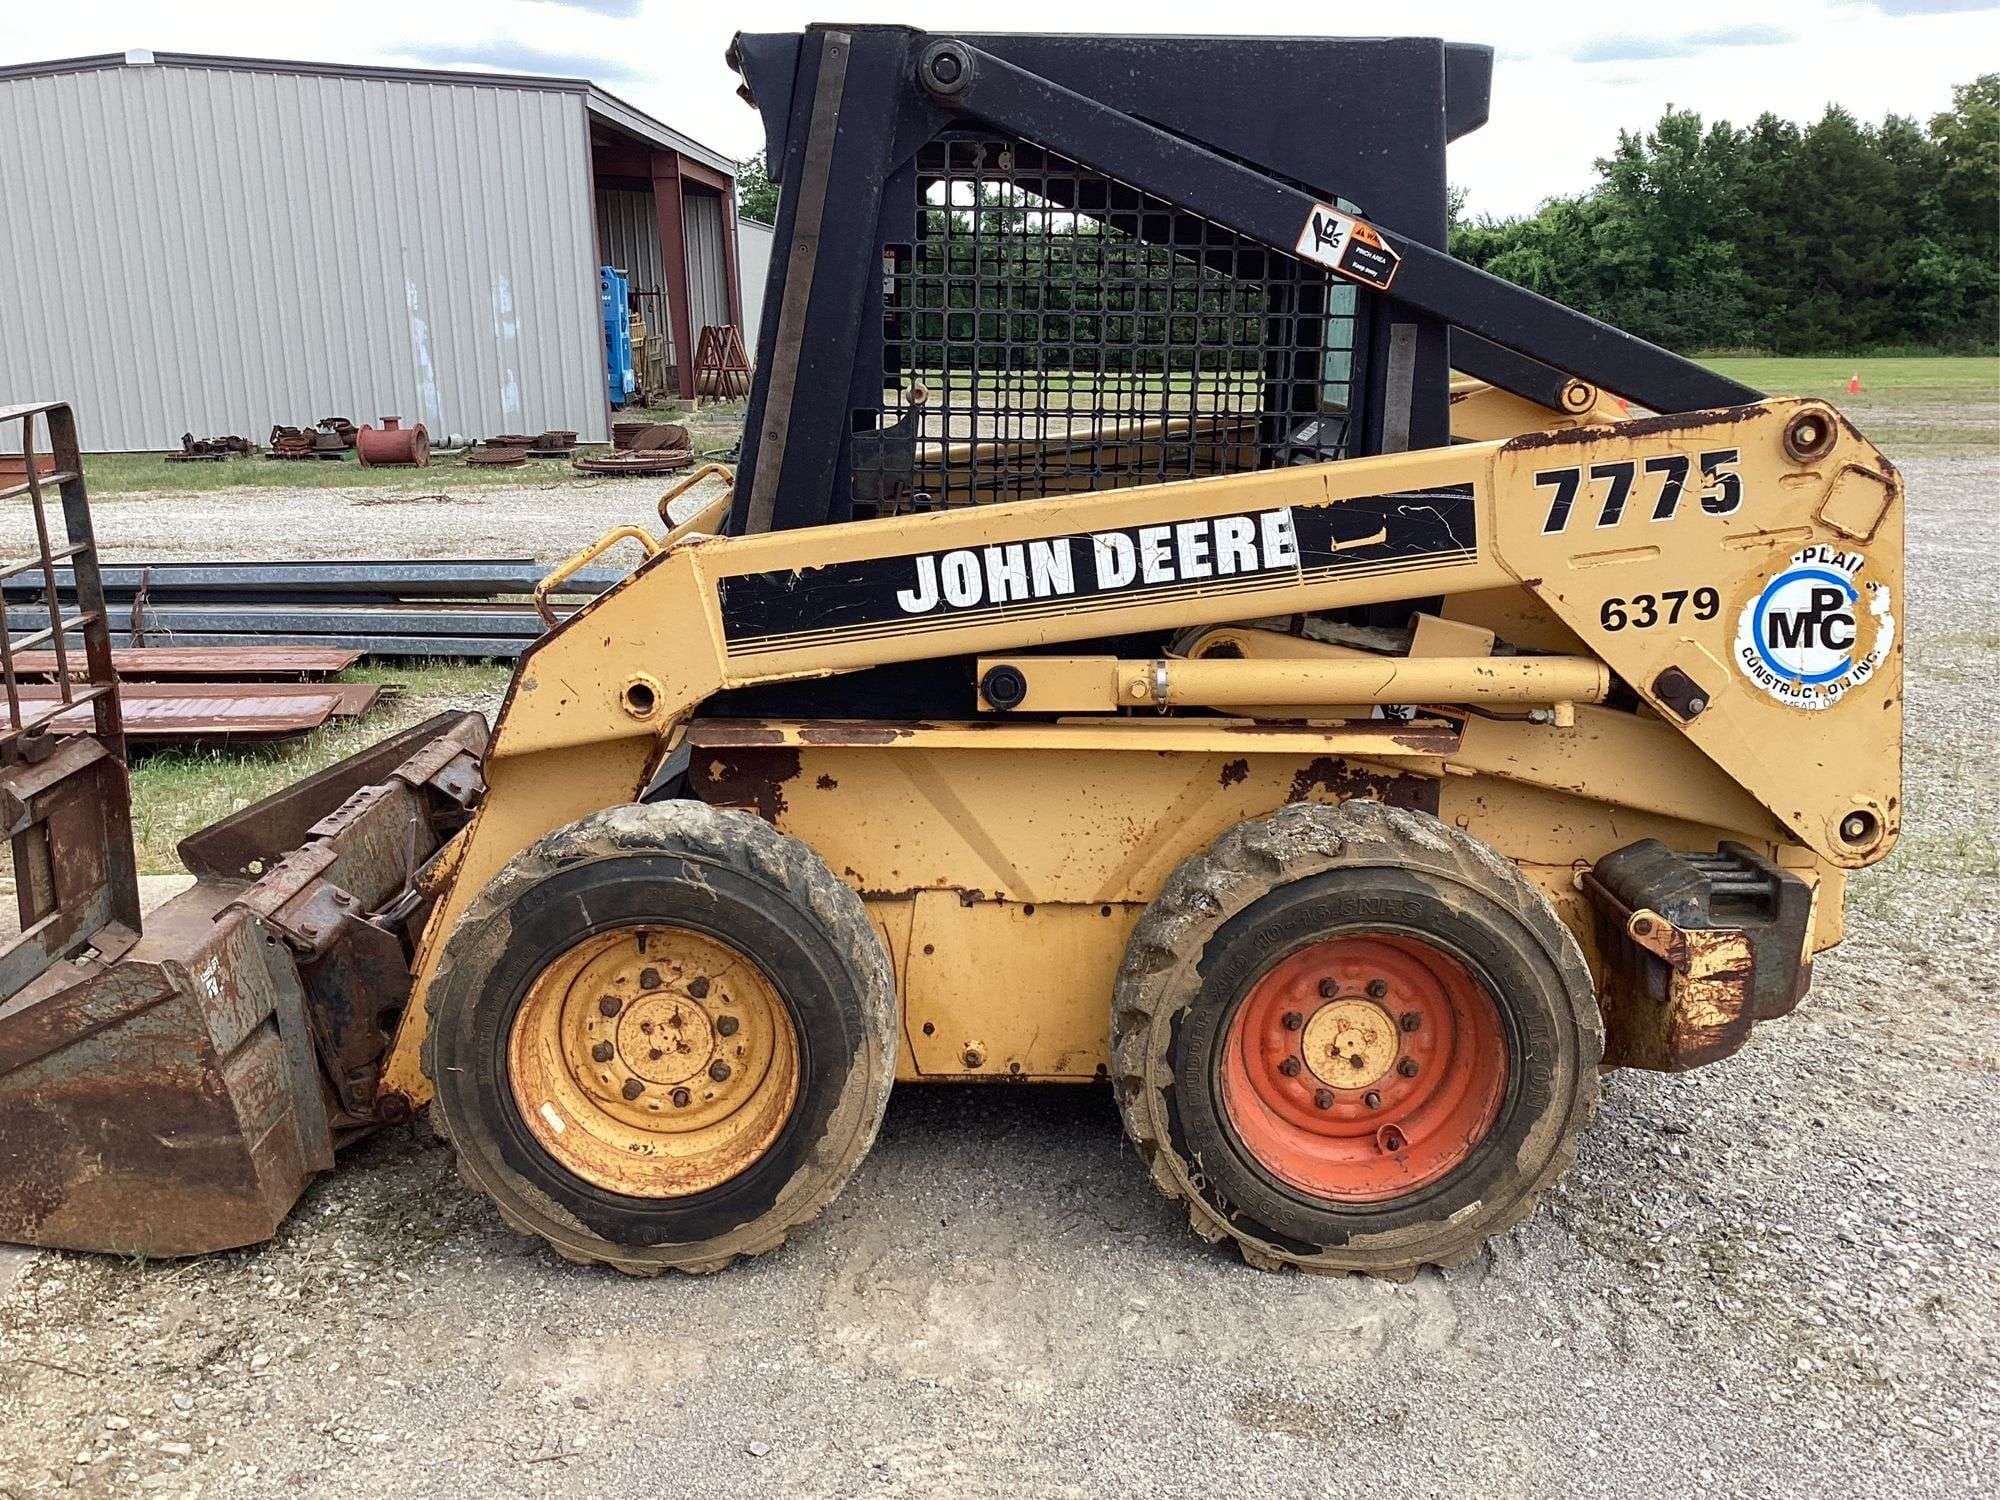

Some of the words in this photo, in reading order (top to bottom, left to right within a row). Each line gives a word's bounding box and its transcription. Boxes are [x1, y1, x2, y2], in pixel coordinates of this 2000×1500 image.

[1533, 448, 1745, 536] 7775
[897, 537, 1075, 614] JOHN
[1095, 506, 1298, 590] DEERE
[1599, 586, 1720, 631] 6379
[1742, 647, 1852, 699] CONSTRUCTON
